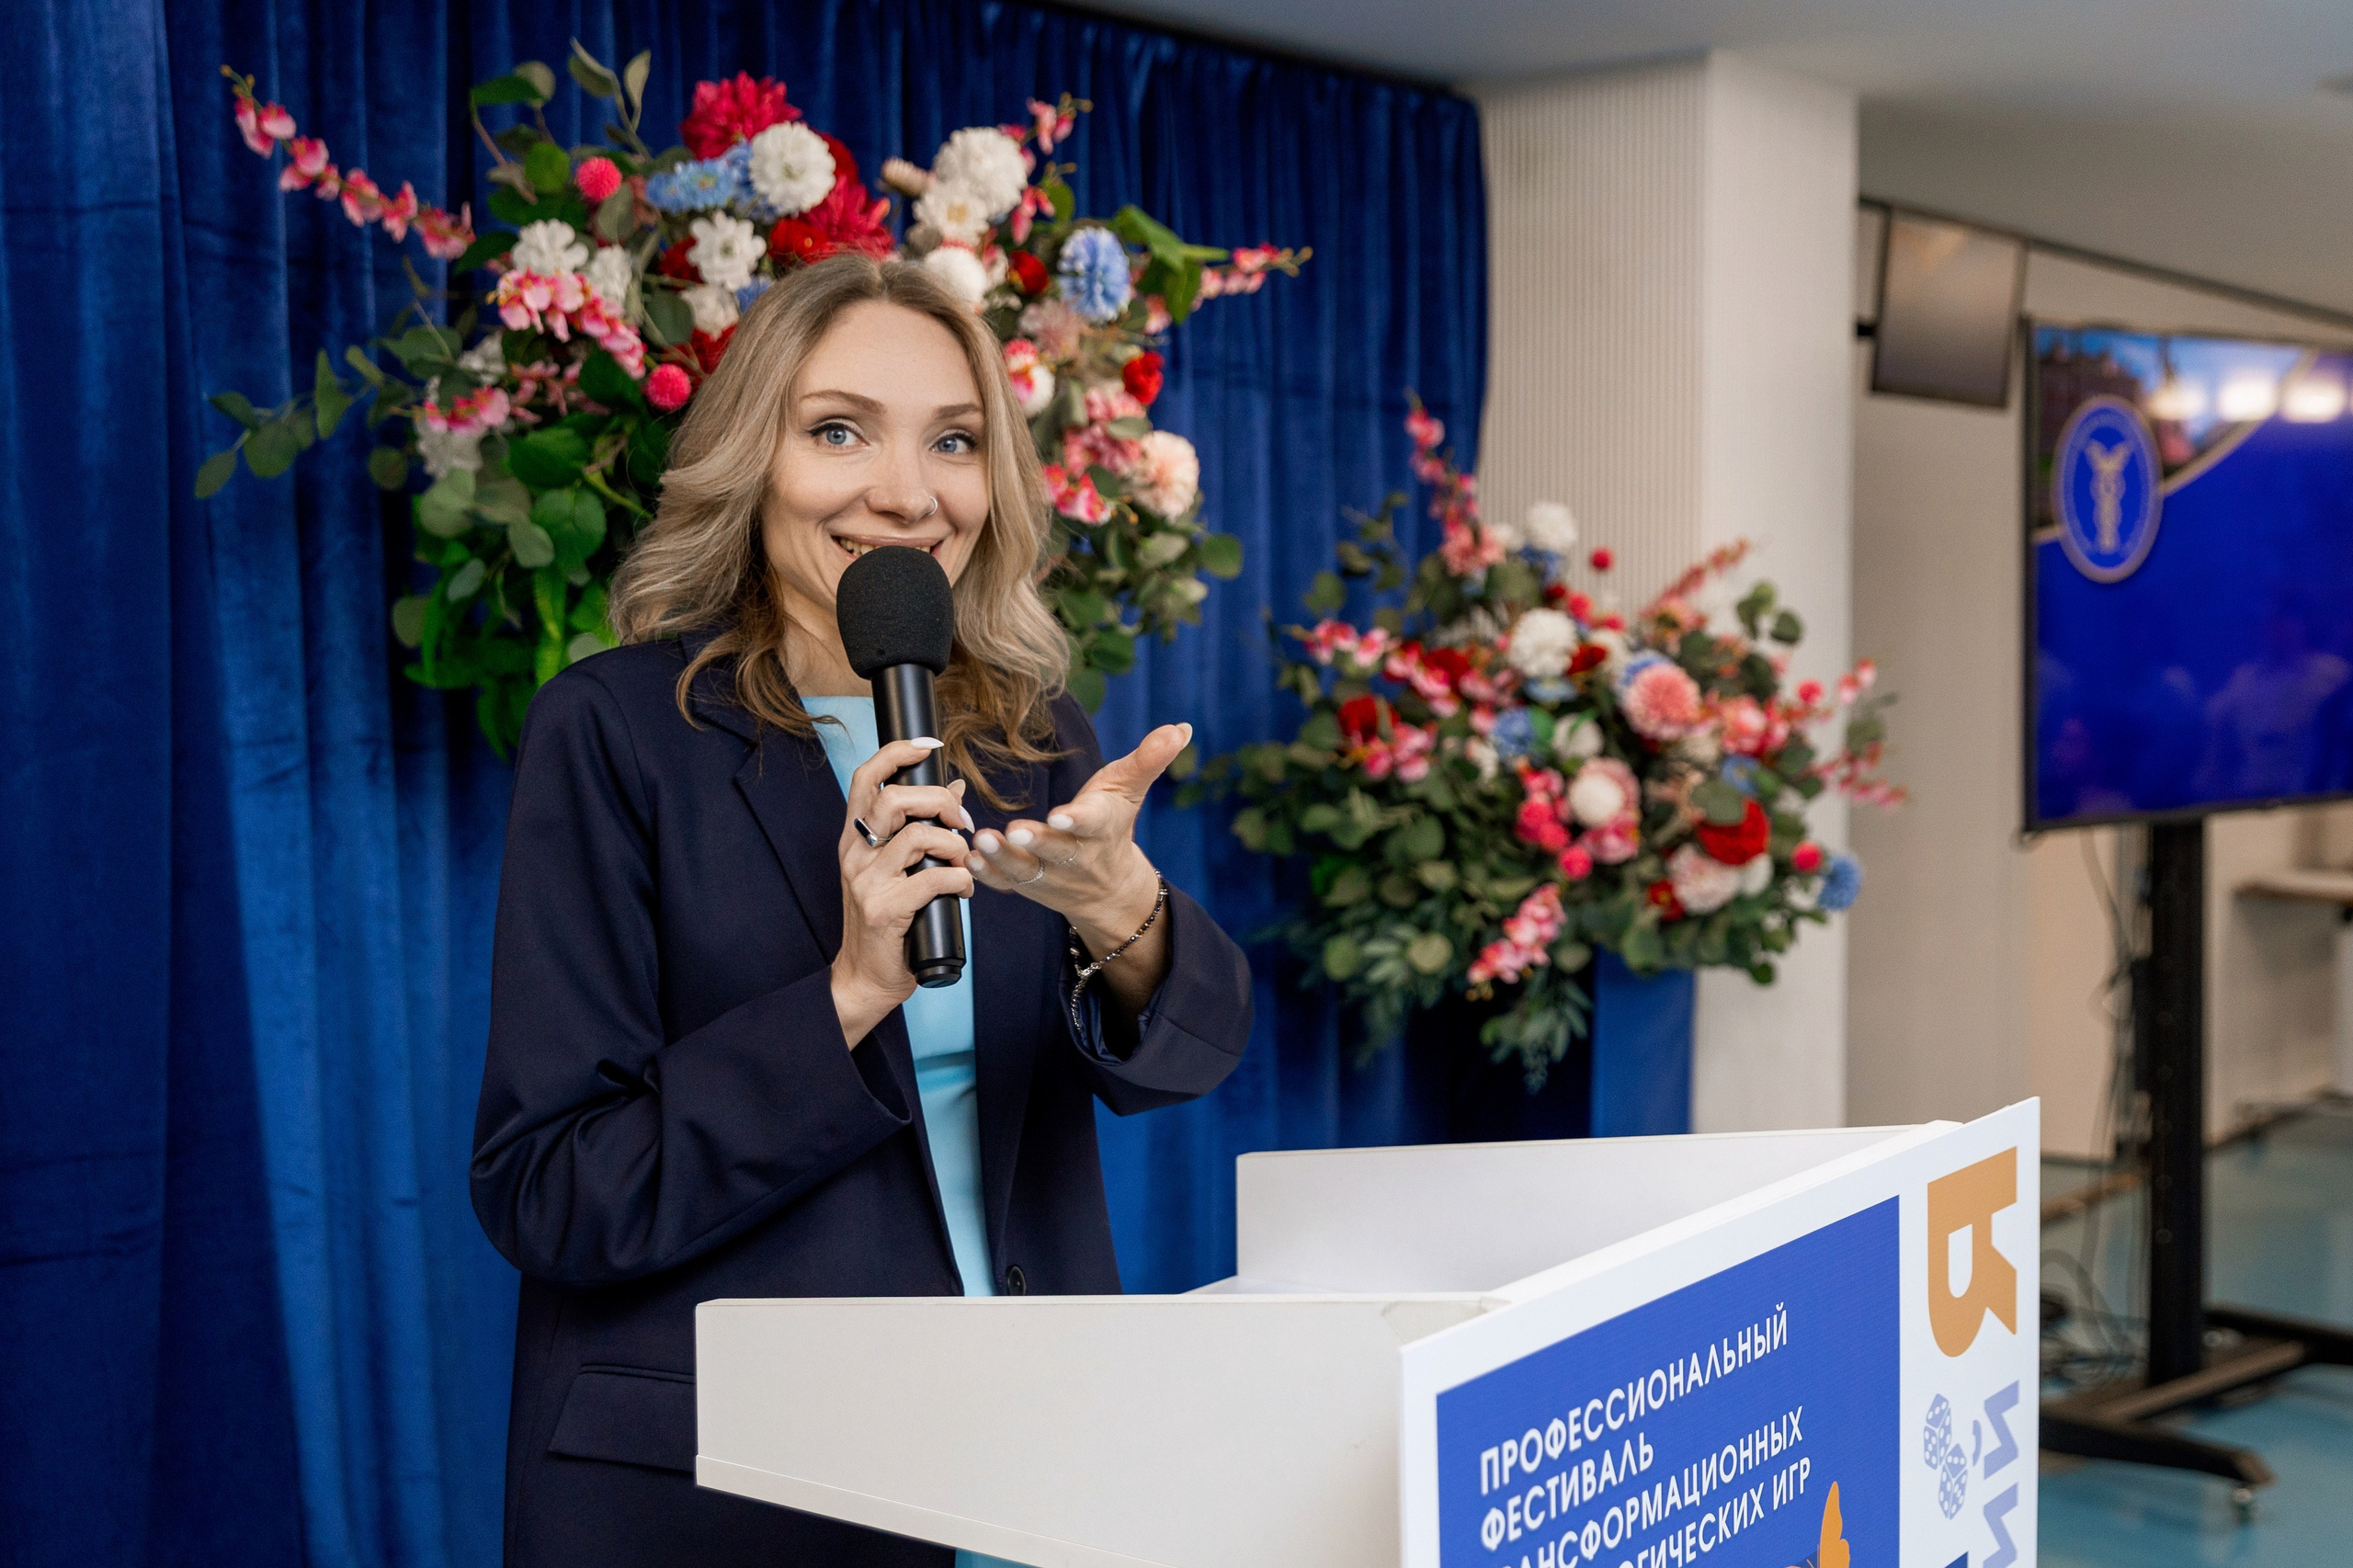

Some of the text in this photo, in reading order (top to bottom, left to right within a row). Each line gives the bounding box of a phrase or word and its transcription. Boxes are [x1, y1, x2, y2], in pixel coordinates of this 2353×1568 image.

[1481, 1301, 1788, 1495] ПРОФЕССИОНАЛЬНЫЙ
[1481, 1432, 1654, 1551] ФЕСТИВАЛЬ
[1773, 1457, 1811, 1511] ИГР
